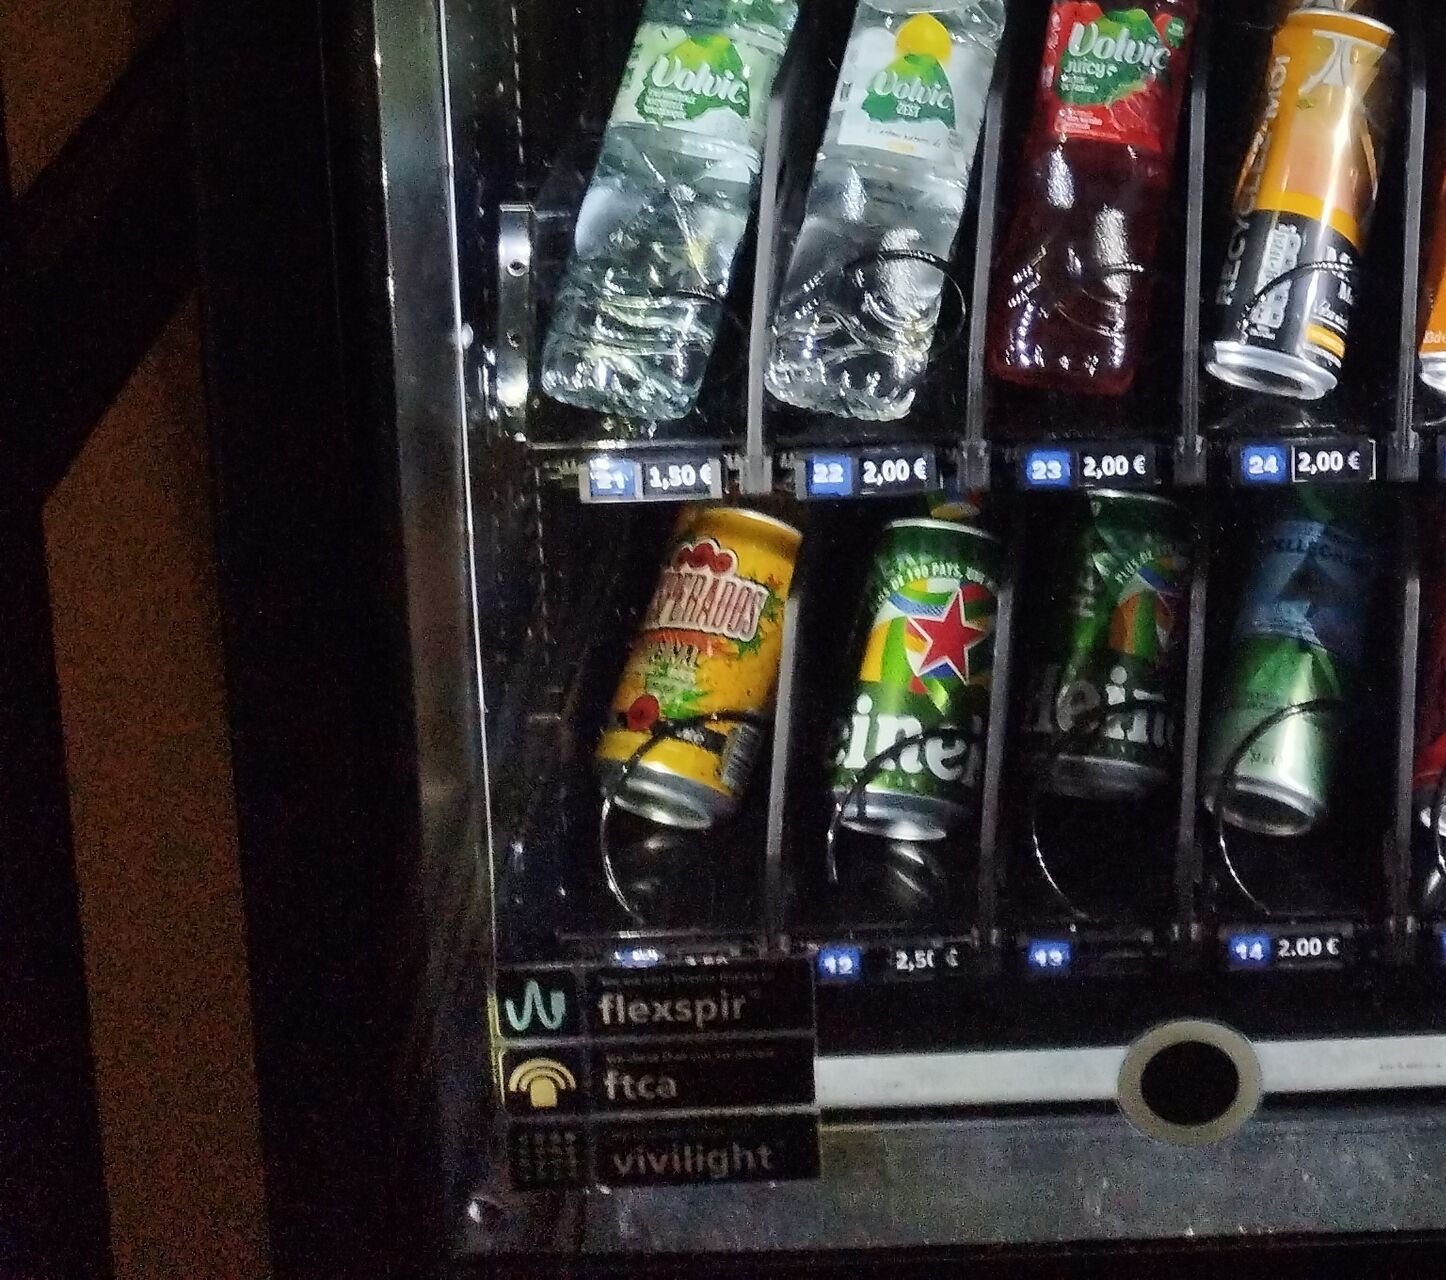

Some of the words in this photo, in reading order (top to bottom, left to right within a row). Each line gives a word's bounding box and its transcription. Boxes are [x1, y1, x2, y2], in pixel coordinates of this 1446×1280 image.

[1068, 21, 1172, 70] Volvic
[651, 53, 748, 105] Volvic
[872, 70, 953, 109] Volvic
[811, 462, 845, 483] 22
[862, 459, 912, 486] 2,00
[913, 459, 931, 483] €
[1031, 458, 1063, 480] 23
[1083, 455, 1134, 478] 2,00
[1136, 455, 1147, 476] €
[1247, 455, 1280, 476] 24
[1298, 453, 1345, 476] 2,00
[1347, 452, 1361, 473] €
[1326, 937, 1340, 956] €
